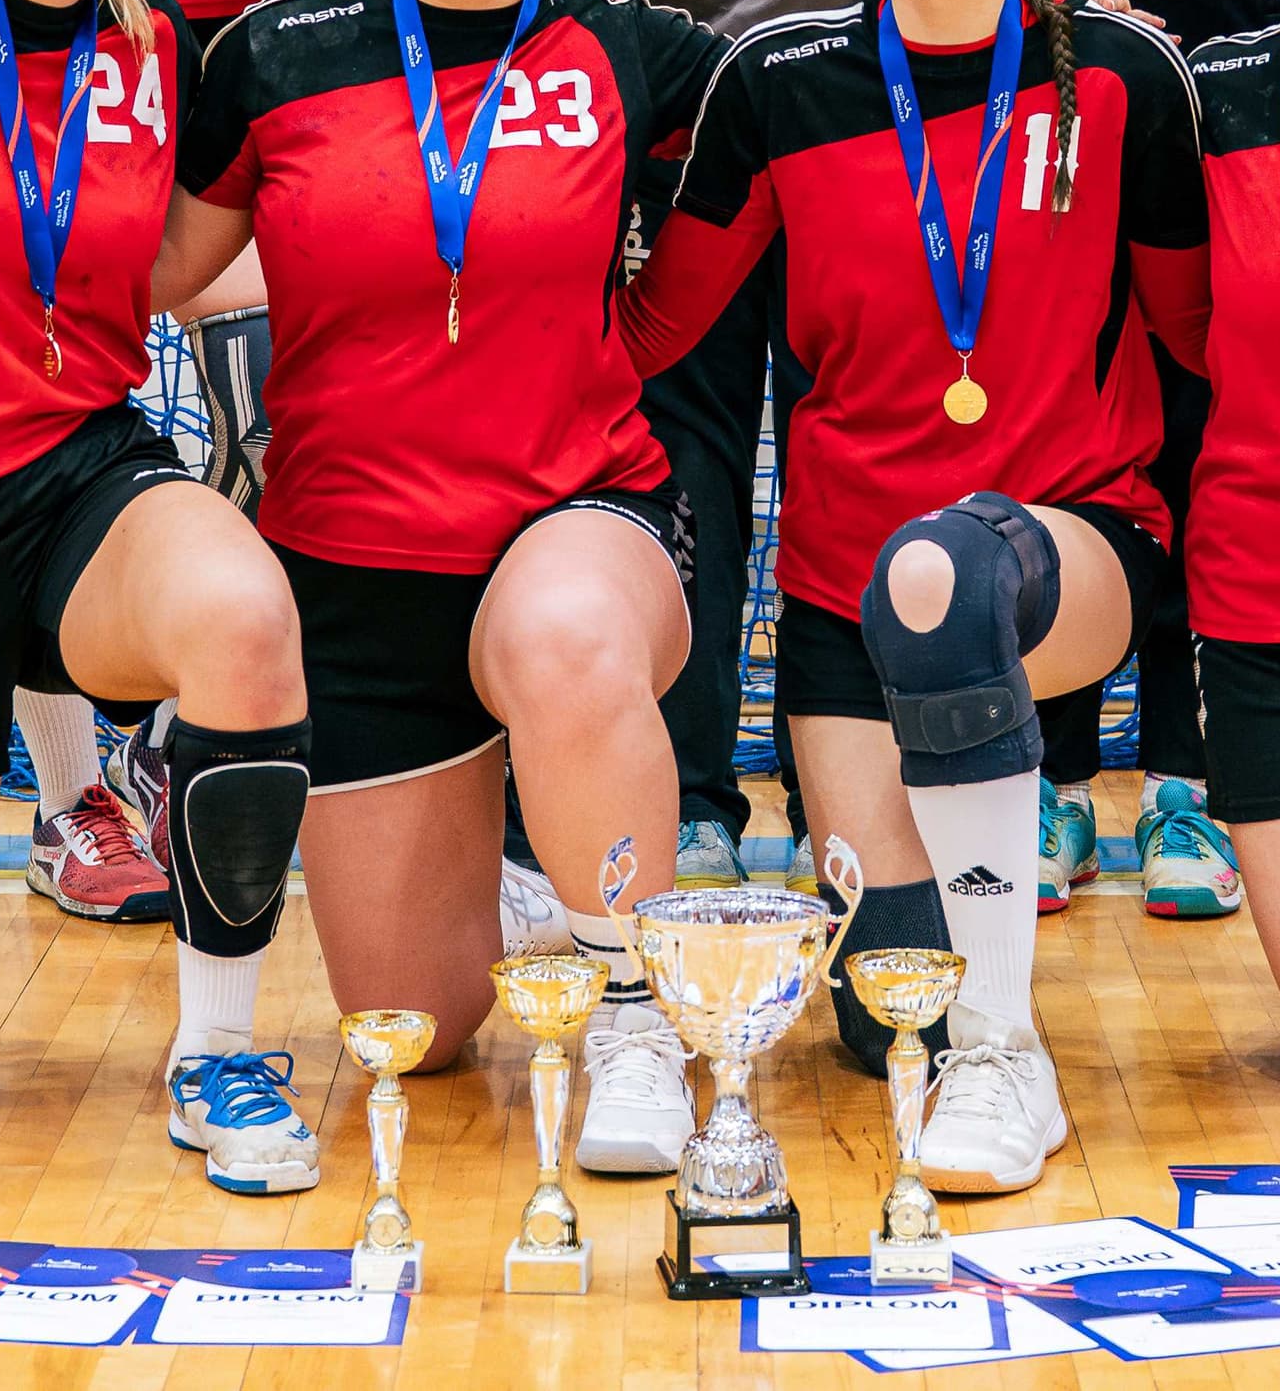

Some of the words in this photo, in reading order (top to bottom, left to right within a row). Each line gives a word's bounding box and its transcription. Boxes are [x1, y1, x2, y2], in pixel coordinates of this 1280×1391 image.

[86, 52, 167, 147] 24
[487, 69, 600, 148] 23
[947, 880, 1014, 897] adidas
[1019, 1251, 1174, 1275] DIPLOM
[195, 1293, 365, 1303] DIPLOM
[789, 1299, 958, 1309] DIPLOM
